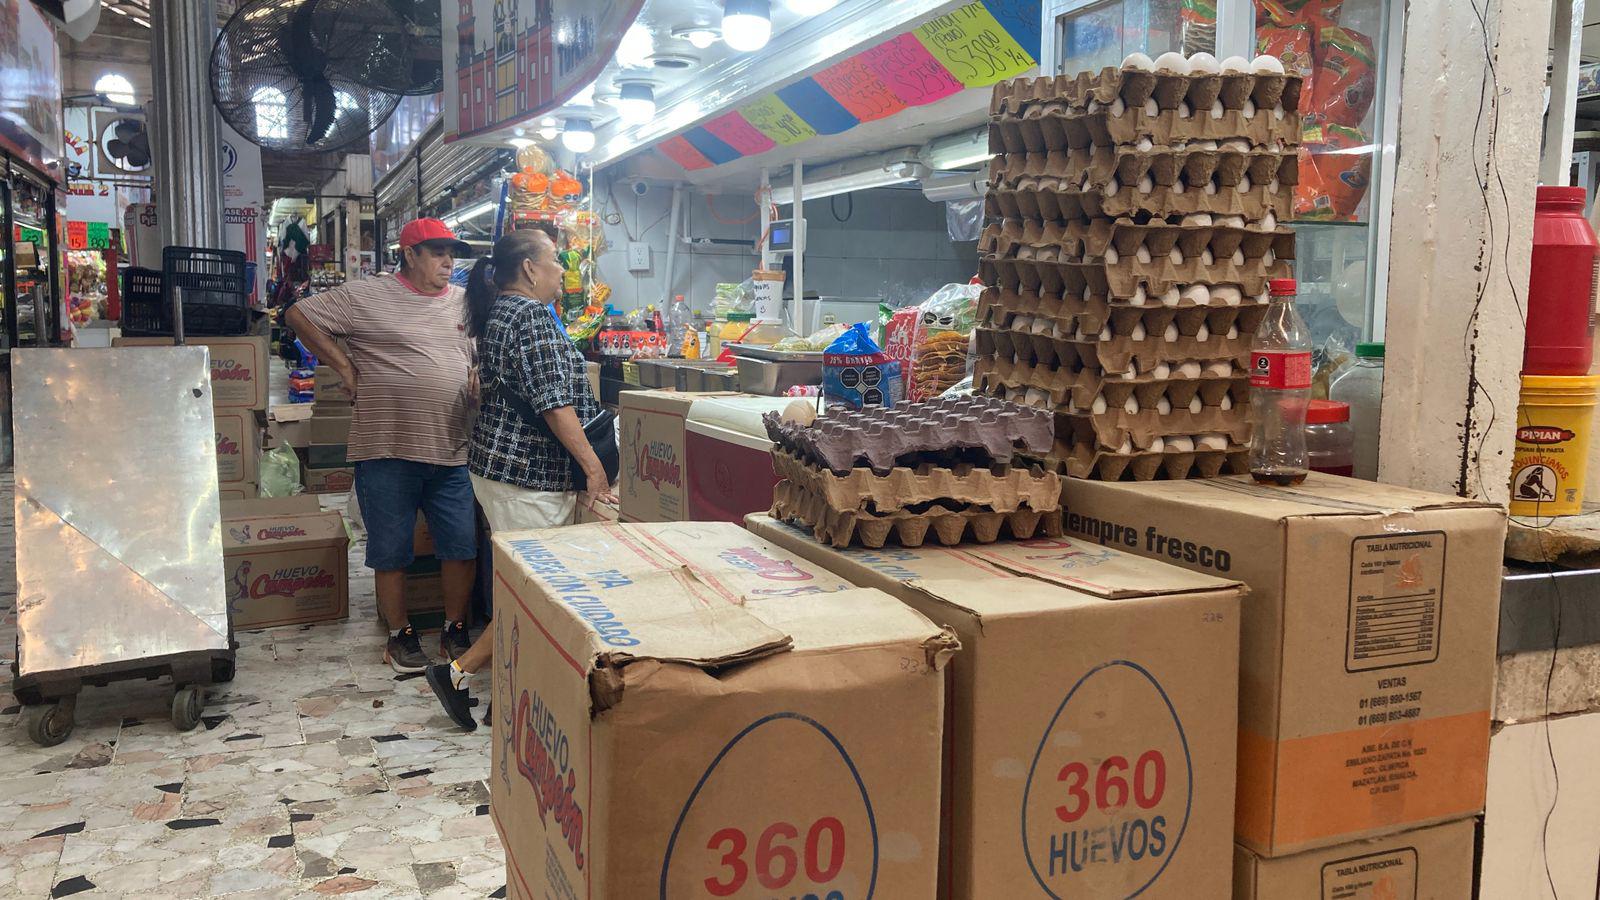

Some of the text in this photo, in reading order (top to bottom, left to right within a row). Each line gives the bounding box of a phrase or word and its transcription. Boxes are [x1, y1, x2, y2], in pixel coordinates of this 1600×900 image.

[650, 441, 673, 460] HUEVO
[1520, 431, 1561, 440] PIPIAN
[1145, 526, 1231, 572] fresco
[1366, 541, 1432, 552] TABLA NUTRICIONAL
[273, 567, 319, 579] HUEVO
[562, 595, 641, 646] CUIDADO
[1378, 677, 1406, 689] VENTAS
[531, 691, 569, 775] HUEVO
[1055, 750, 1166, 823] 360
[704, 816, 845, 897] 360
[1049, 815, 1166, 877] HUEVOS
[1336, 858, 1404, 877] TABLA NUTRICIONAL
